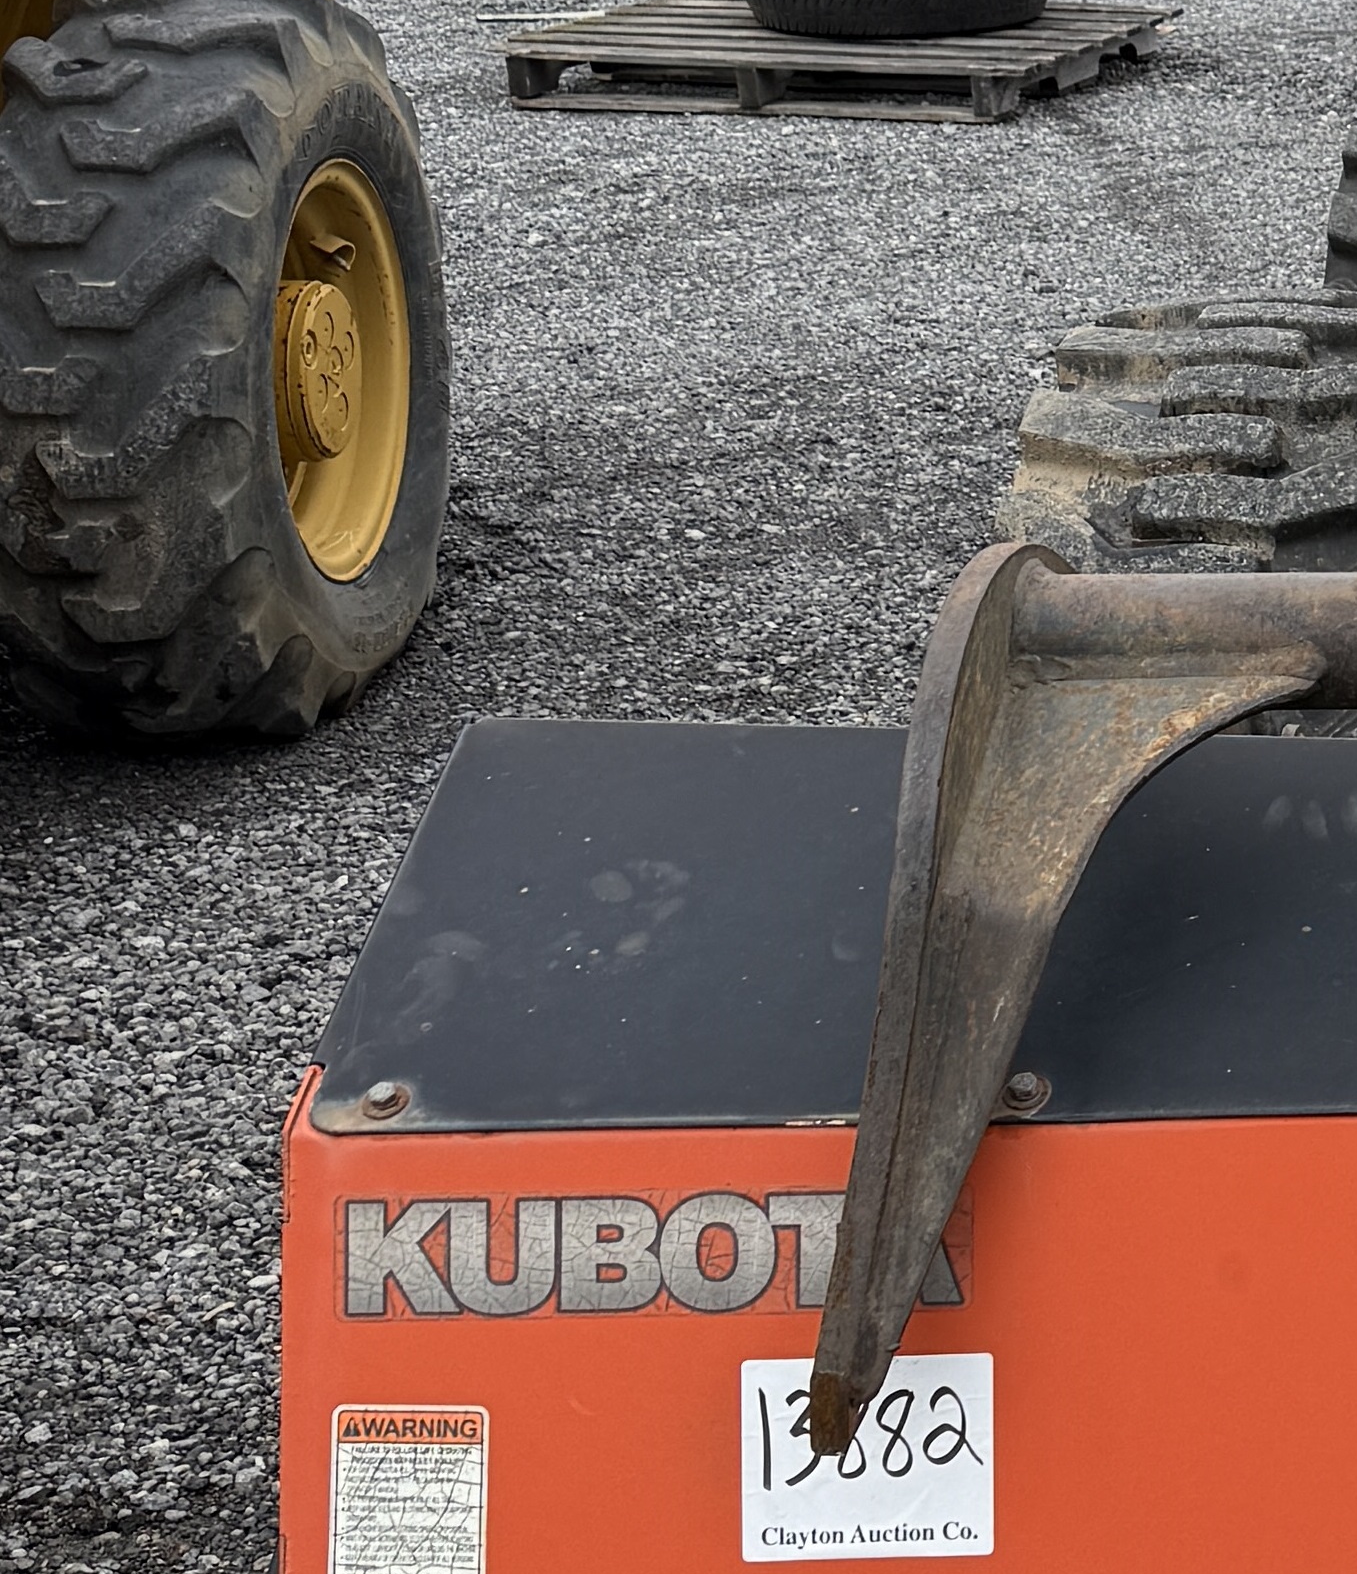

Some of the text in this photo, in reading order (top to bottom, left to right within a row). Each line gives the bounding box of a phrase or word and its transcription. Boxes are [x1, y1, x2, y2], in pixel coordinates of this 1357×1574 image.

[344, 1193, 964, 1317] KUBOT
[362, 1417, 477, 1438] WARNING
[761, 1521, 979, 1549] Clayton Auction Co.
